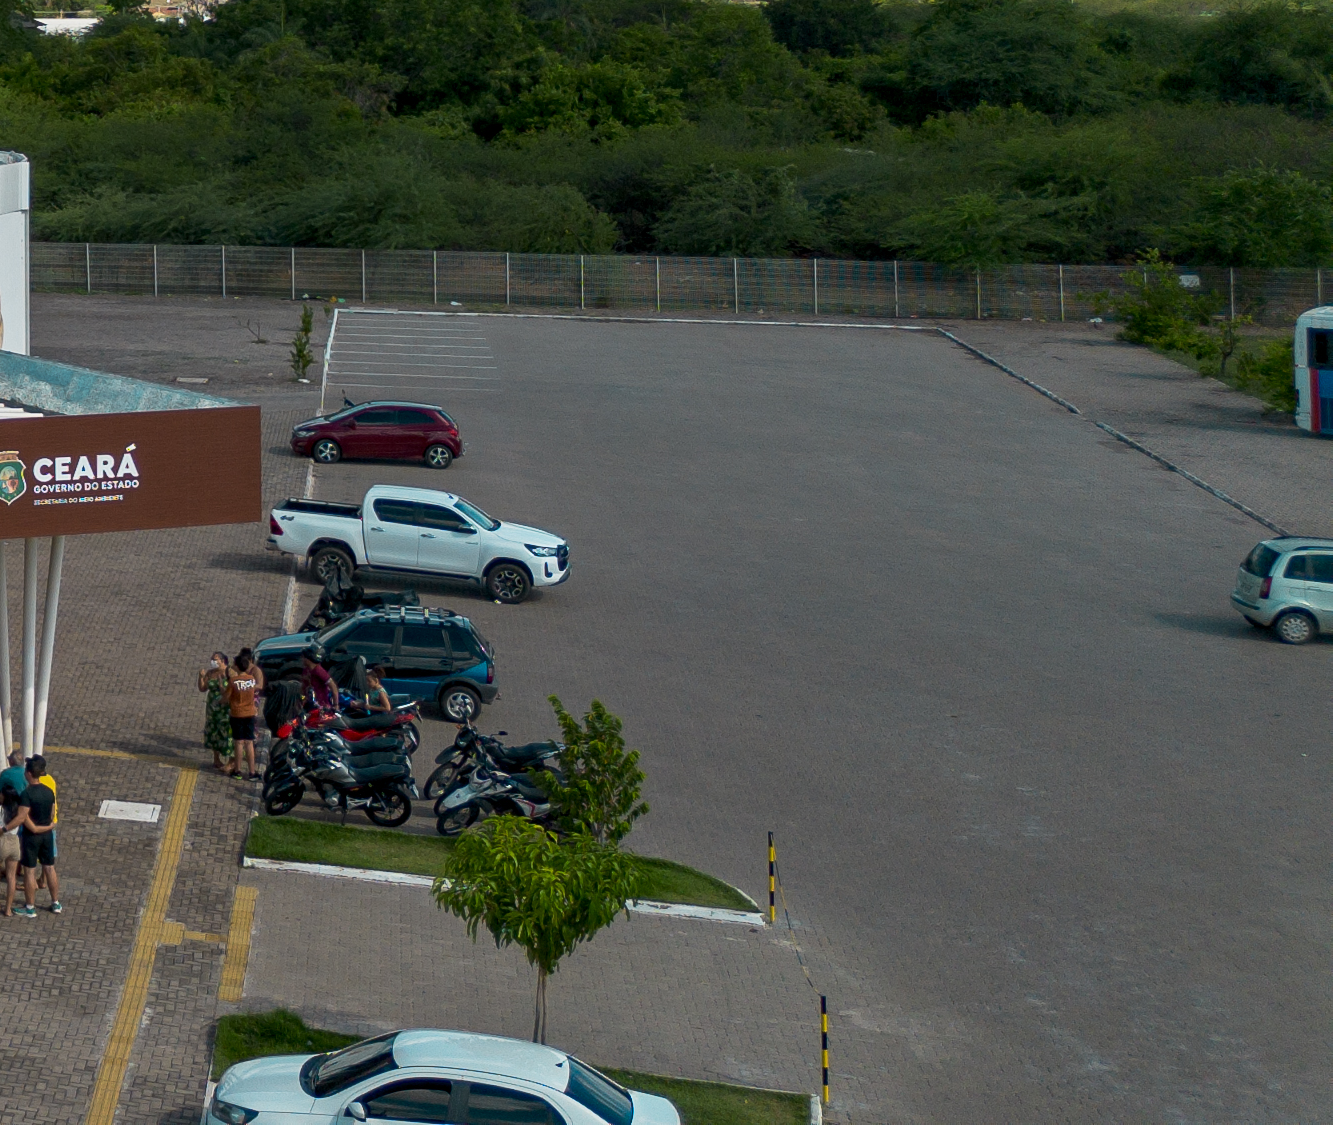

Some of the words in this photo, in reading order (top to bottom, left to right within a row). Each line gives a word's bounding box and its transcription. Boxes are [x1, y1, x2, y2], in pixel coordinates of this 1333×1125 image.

[32, 443, 140, 482] CEARÁ
[33, 483, 83, 494] GOVERNO
[84, 482, 99, 491] DO
[101, 479, 140, 491] ESTADO
